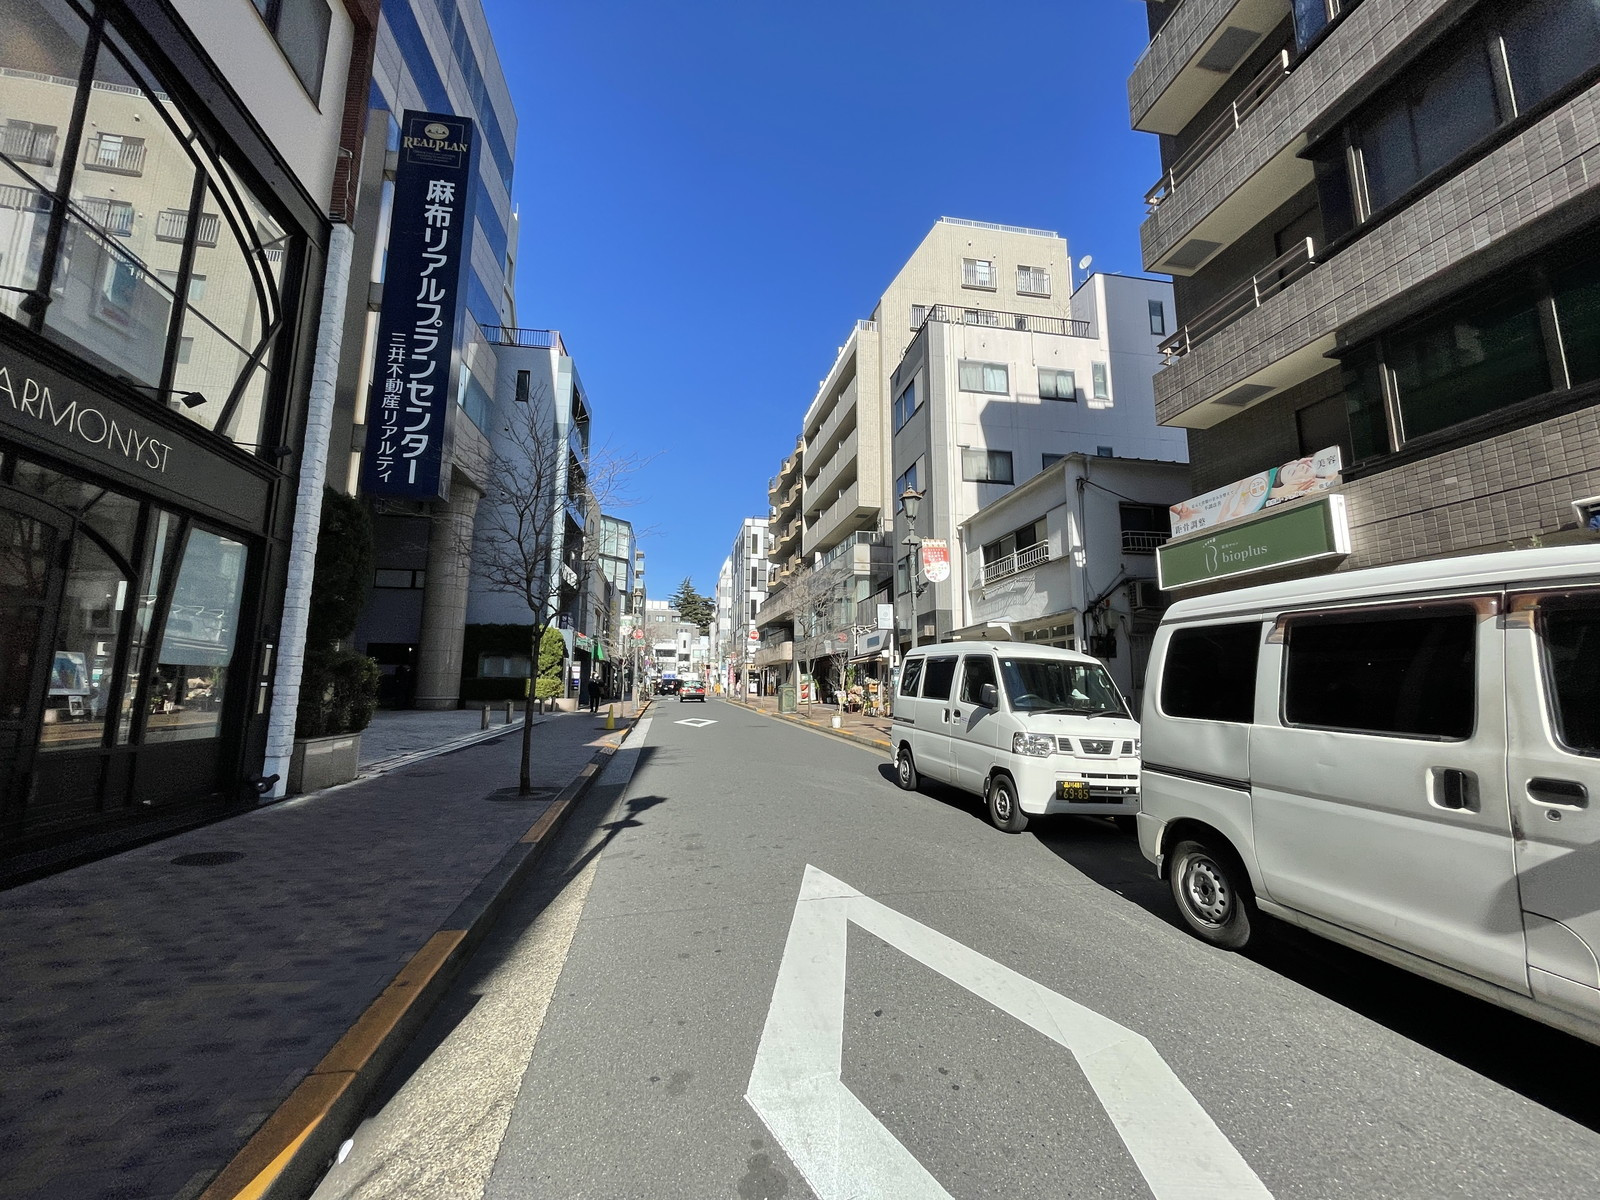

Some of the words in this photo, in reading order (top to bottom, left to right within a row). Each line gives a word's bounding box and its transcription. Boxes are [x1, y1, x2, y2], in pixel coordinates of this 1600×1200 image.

[403, 136, 468, 152] REALPLAN
[401, 180, 455, 484] 麻布リアルプランセンター
[376, 333, 406, 483] 三井不動産リアルティ
[1222, 545, 1268, 563] bioplus
